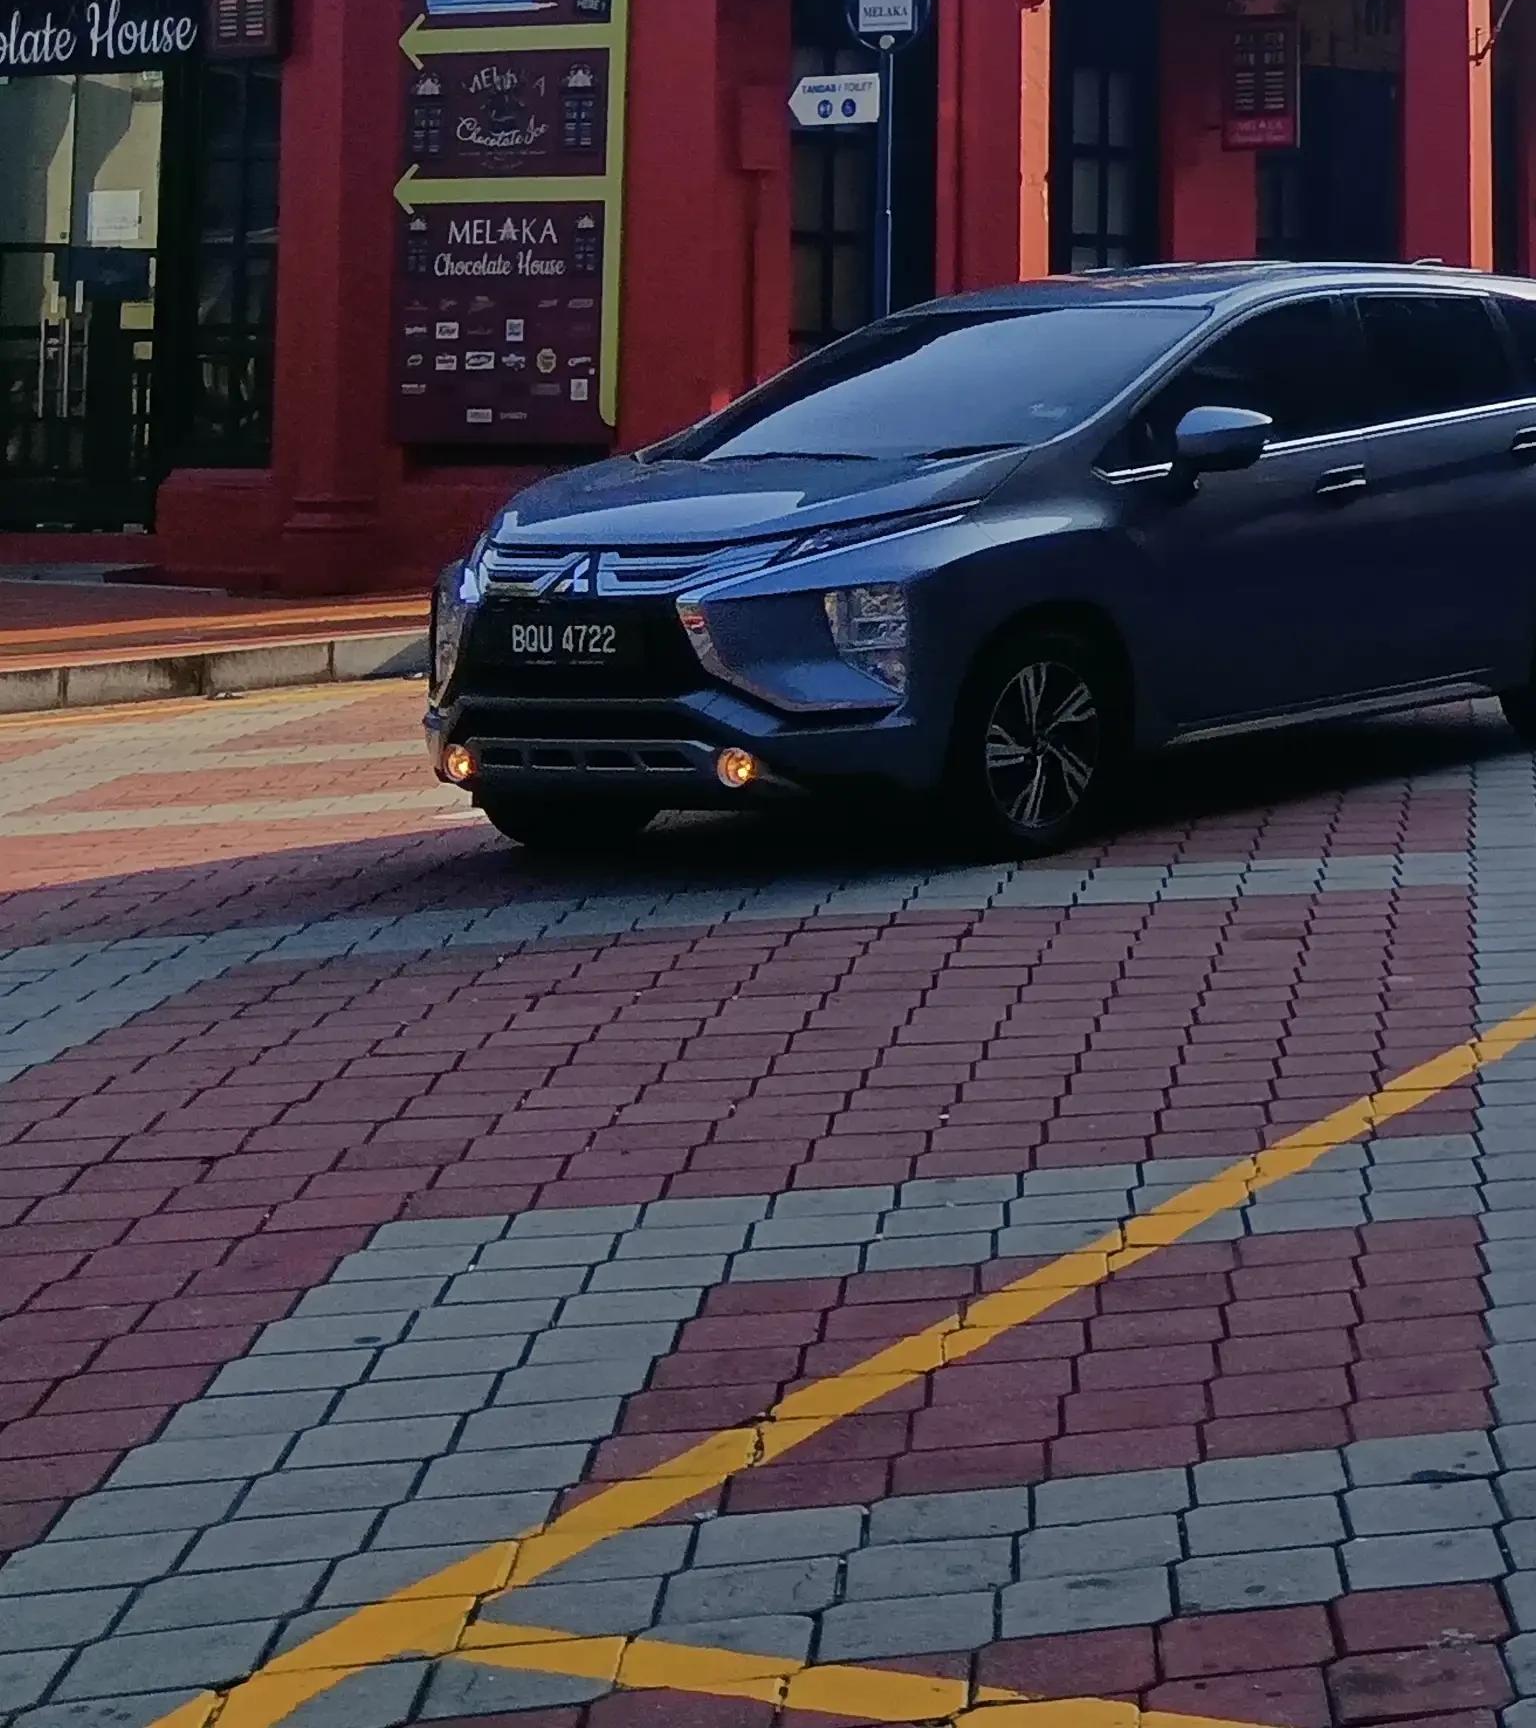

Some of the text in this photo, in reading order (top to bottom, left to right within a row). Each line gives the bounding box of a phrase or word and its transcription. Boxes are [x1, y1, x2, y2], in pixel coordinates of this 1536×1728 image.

[863, 5, 909, 19] MELAKA
[447, 217, 558, 245] MELAKA
[433, 248, 566, 277] Chocolate House
[511, 623, 617, 654] BQU 4722
